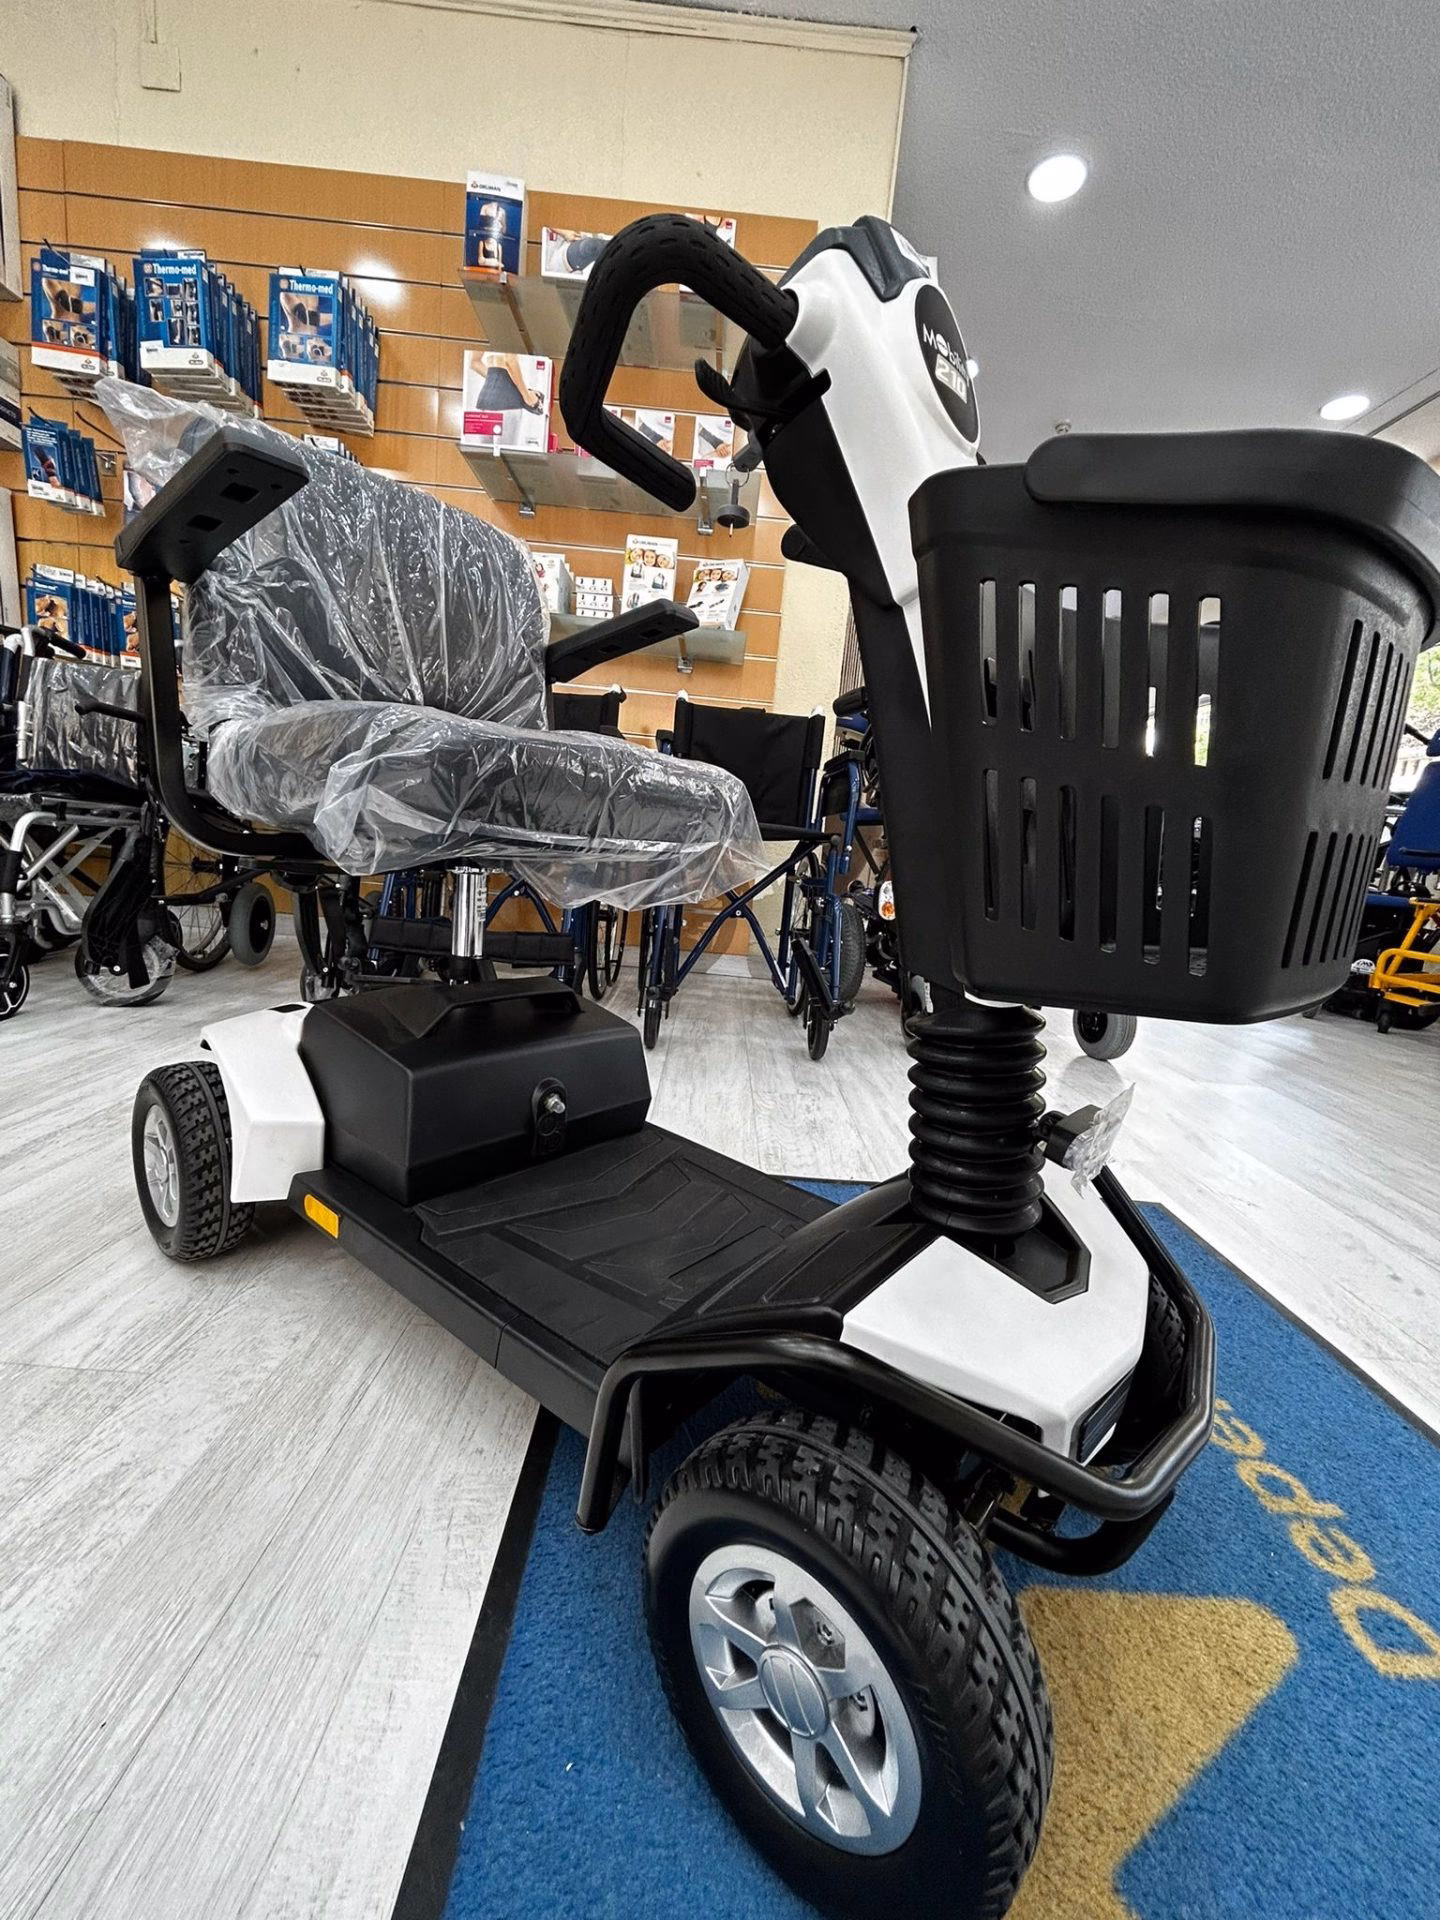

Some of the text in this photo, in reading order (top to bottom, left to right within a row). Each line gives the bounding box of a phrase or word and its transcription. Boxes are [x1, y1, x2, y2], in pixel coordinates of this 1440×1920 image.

[153, 263, 197, 275] Thermo-med
[289, 279, 334, 295] Thermo-med
[936, 358, 967, 399] 210
[1209, 1398, 1440, 1678] Depe
